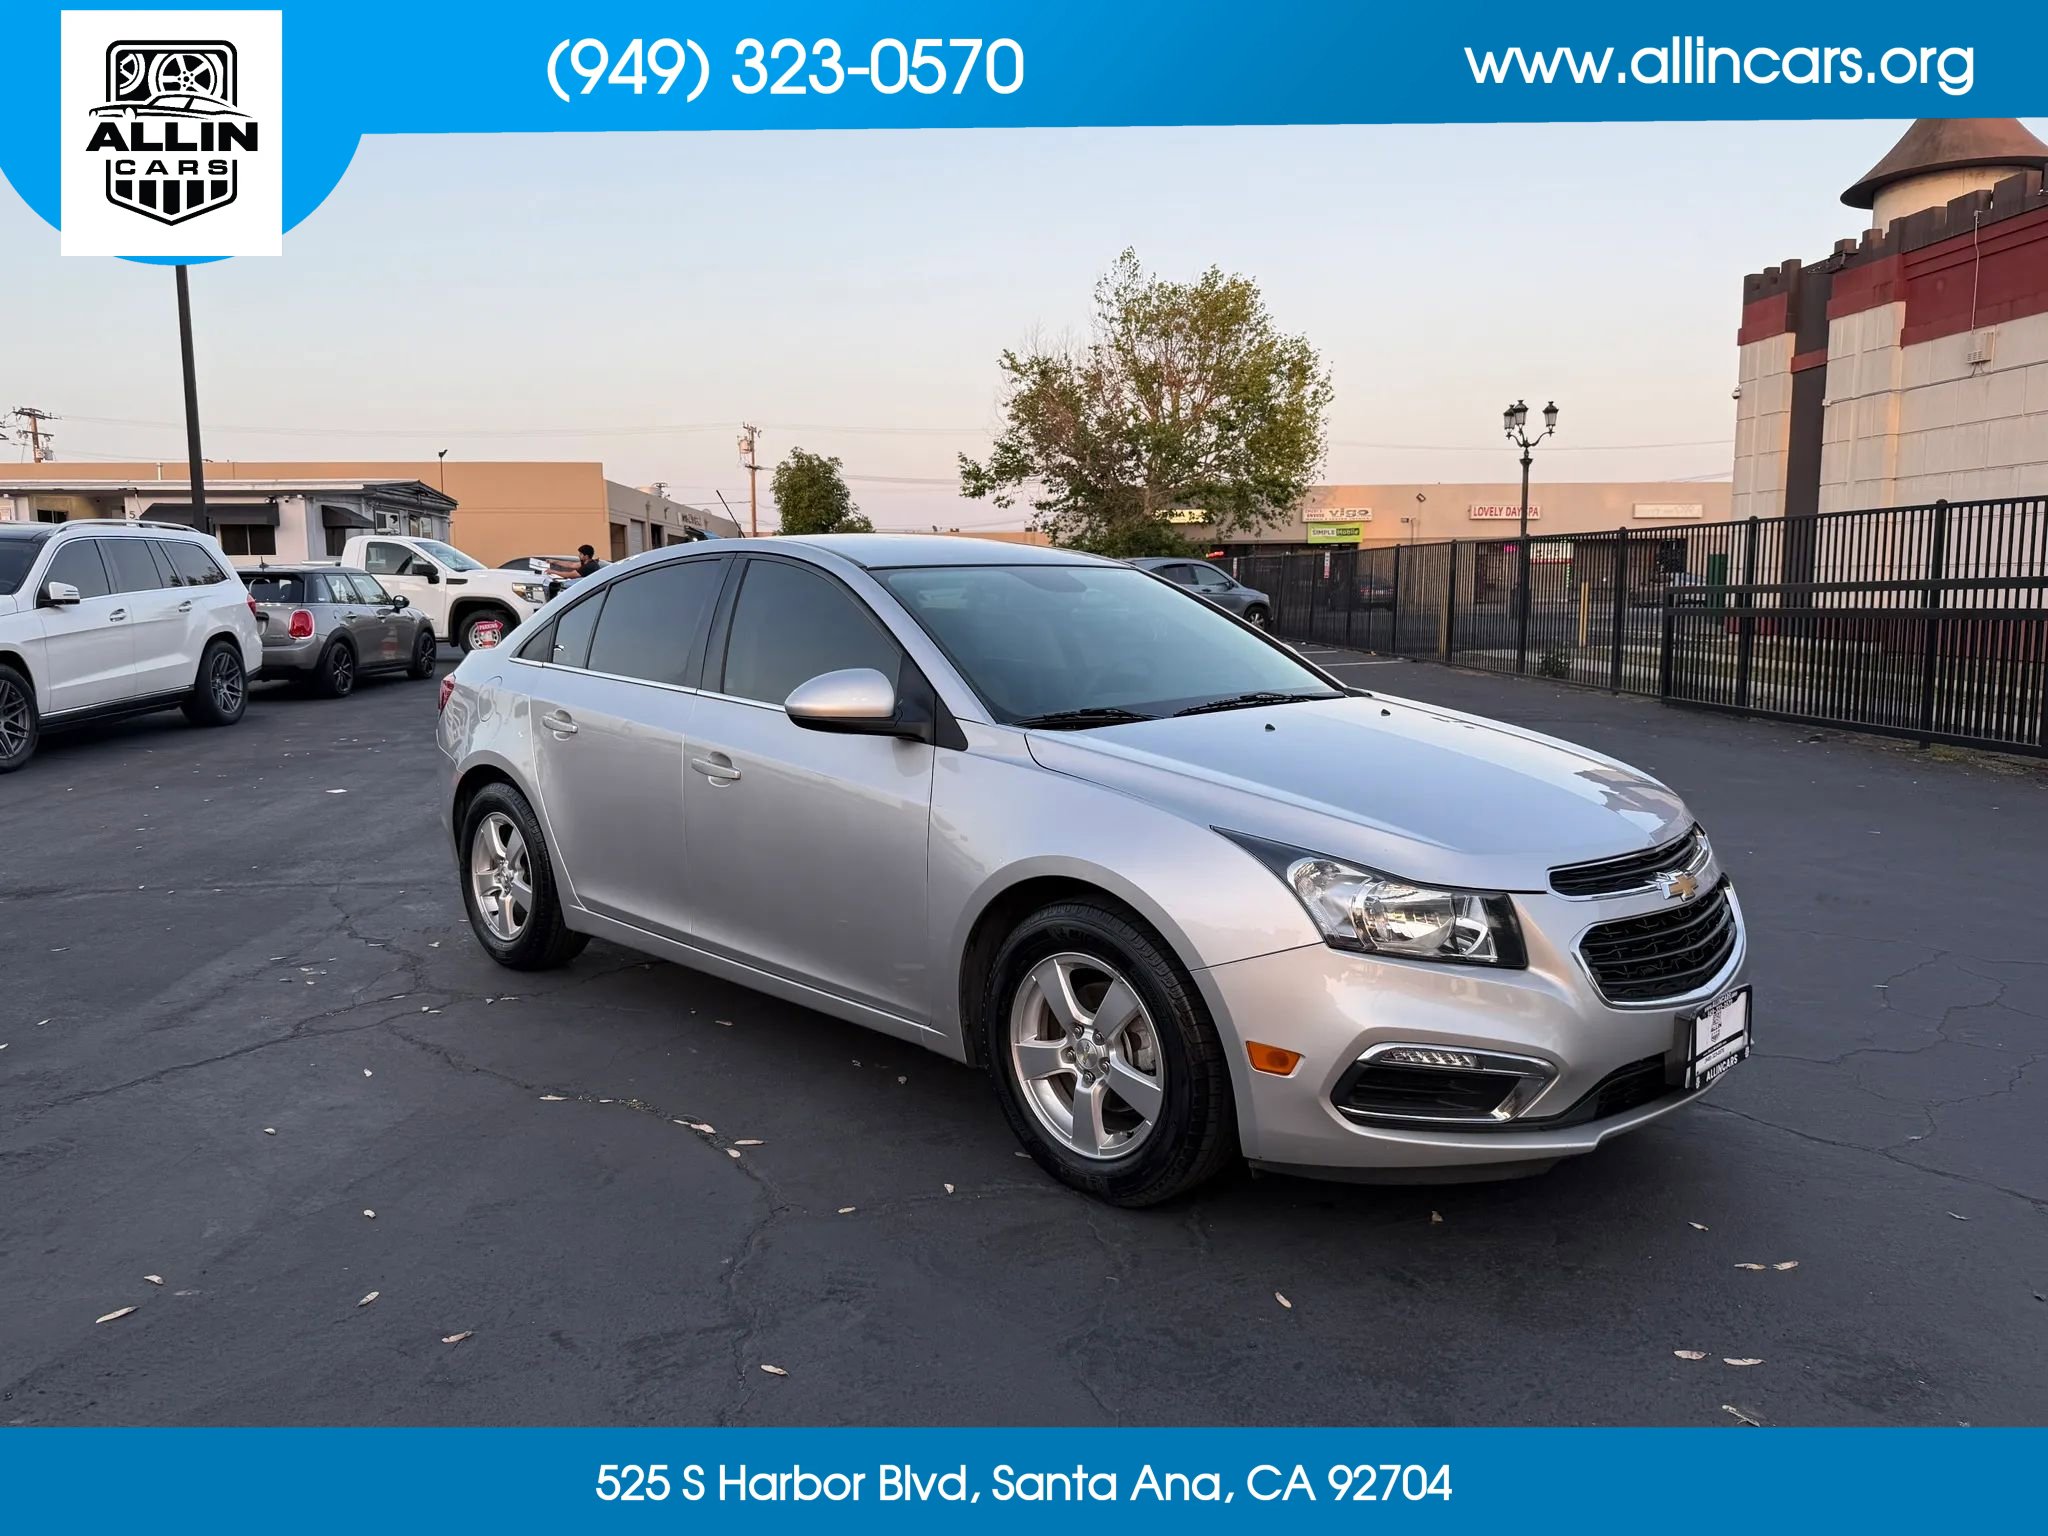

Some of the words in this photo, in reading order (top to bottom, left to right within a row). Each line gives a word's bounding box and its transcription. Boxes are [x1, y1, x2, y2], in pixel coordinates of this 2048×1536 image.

[129, 510, 136, 520] 5
[1473, 506, 1503, 517] LOVELY
[1505, 506, 1522, 517] DAY
[1312, 528, 1336, 536] SIMPLE
[1705, 1053, 1738, 1082] ALLINCARS
